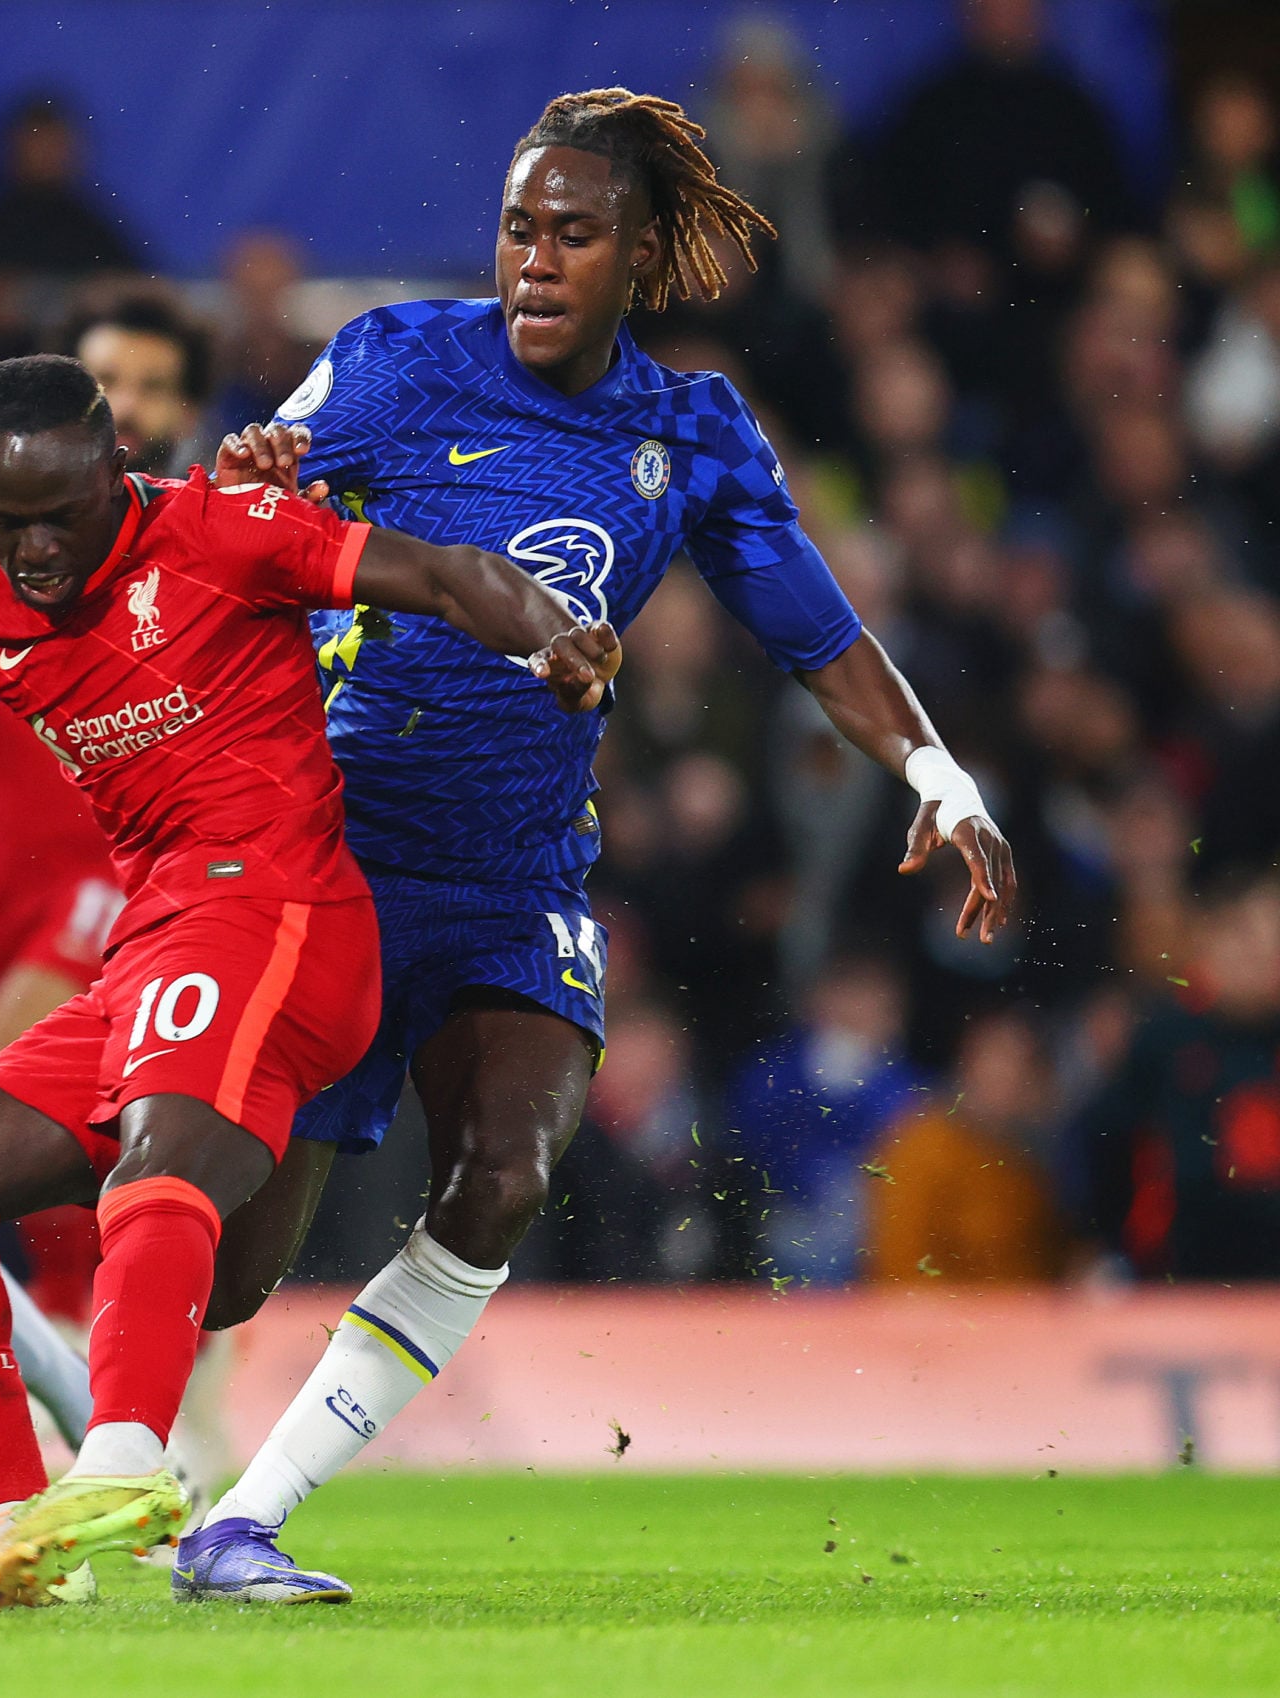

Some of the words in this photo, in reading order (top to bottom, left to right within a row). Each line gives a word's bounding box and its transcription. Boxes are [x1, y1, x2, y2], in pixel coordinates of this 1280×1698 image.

[131, 629, 168, 652] LFC
[66, 684, 190, 744] standard
[80, 704, 204, 764] chartered
[128, 972, 220, 1051] 10
[337, 1385, 376, 1434] CFC
